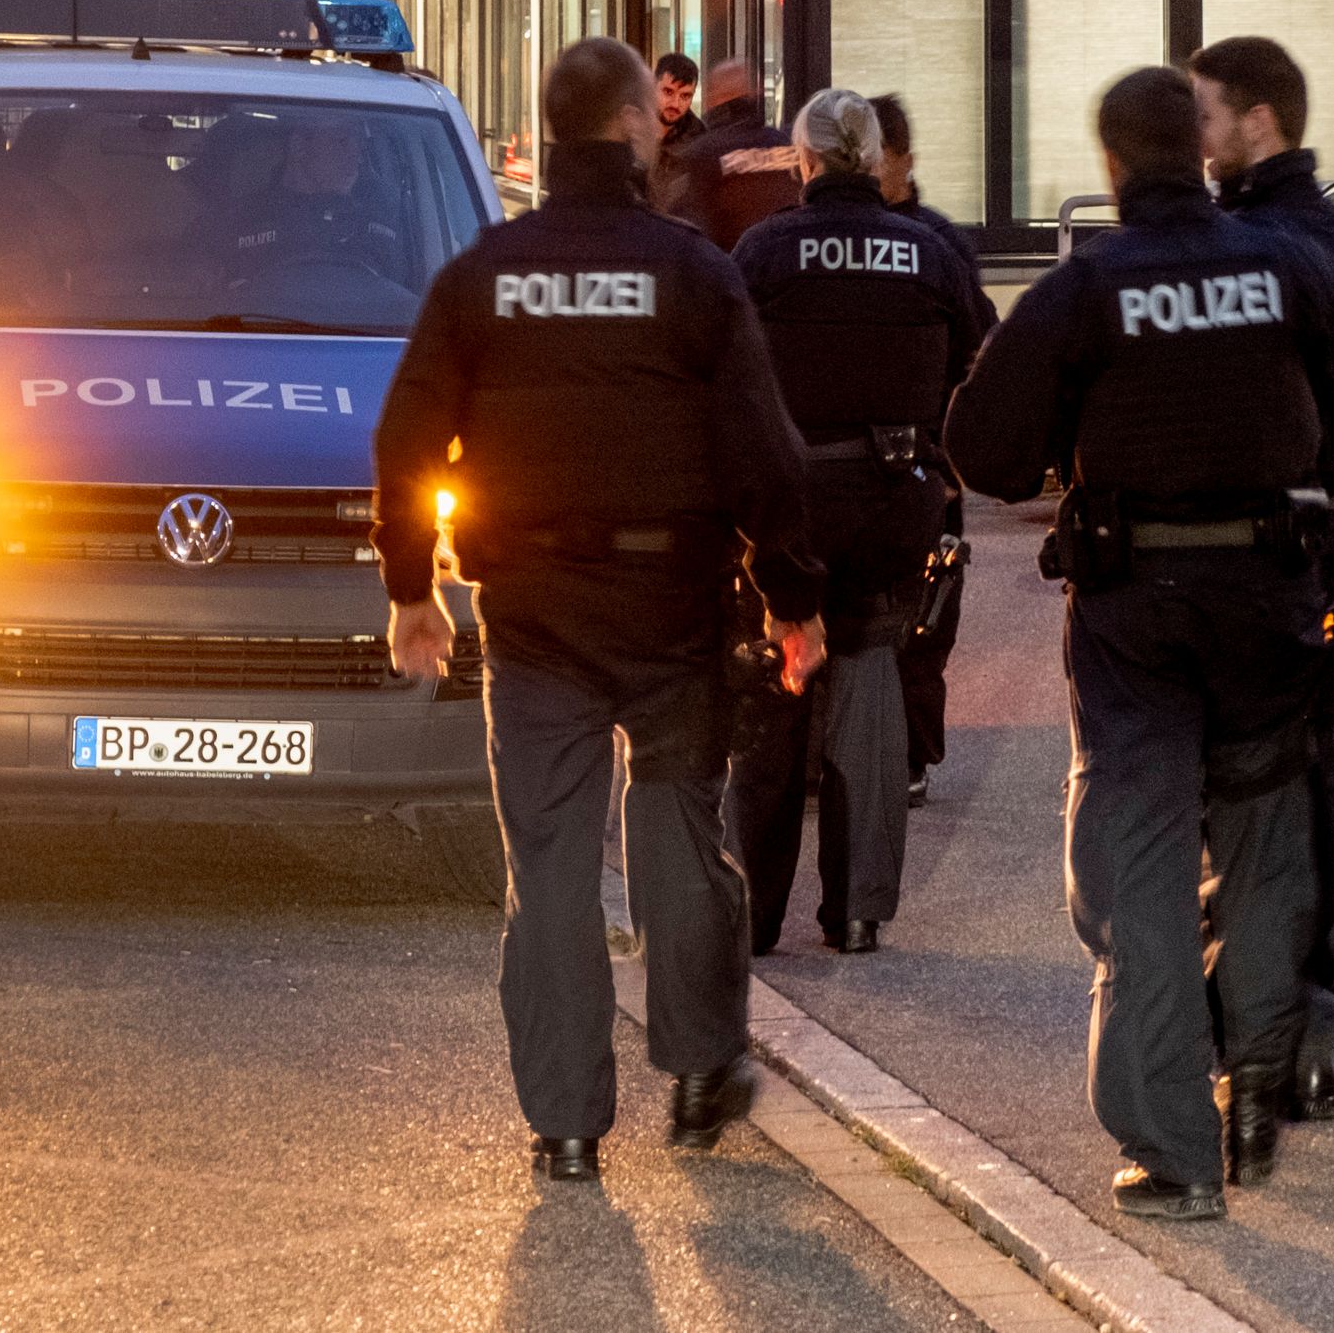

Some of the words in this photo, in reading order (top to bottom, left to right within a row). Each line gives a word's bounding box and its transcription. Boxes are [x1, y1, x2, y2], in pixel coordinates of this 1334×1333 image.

[799, 237, 919, 275] POLIZEI
[494, 271, 656, 318] POLIZEI
[1119, 270, 1283, 337] POLIZEI
[19, 376, 354, 415] POLIZEI
[101, 726, 149, 761] BP
[173, 728, 306, 765] 28-268
